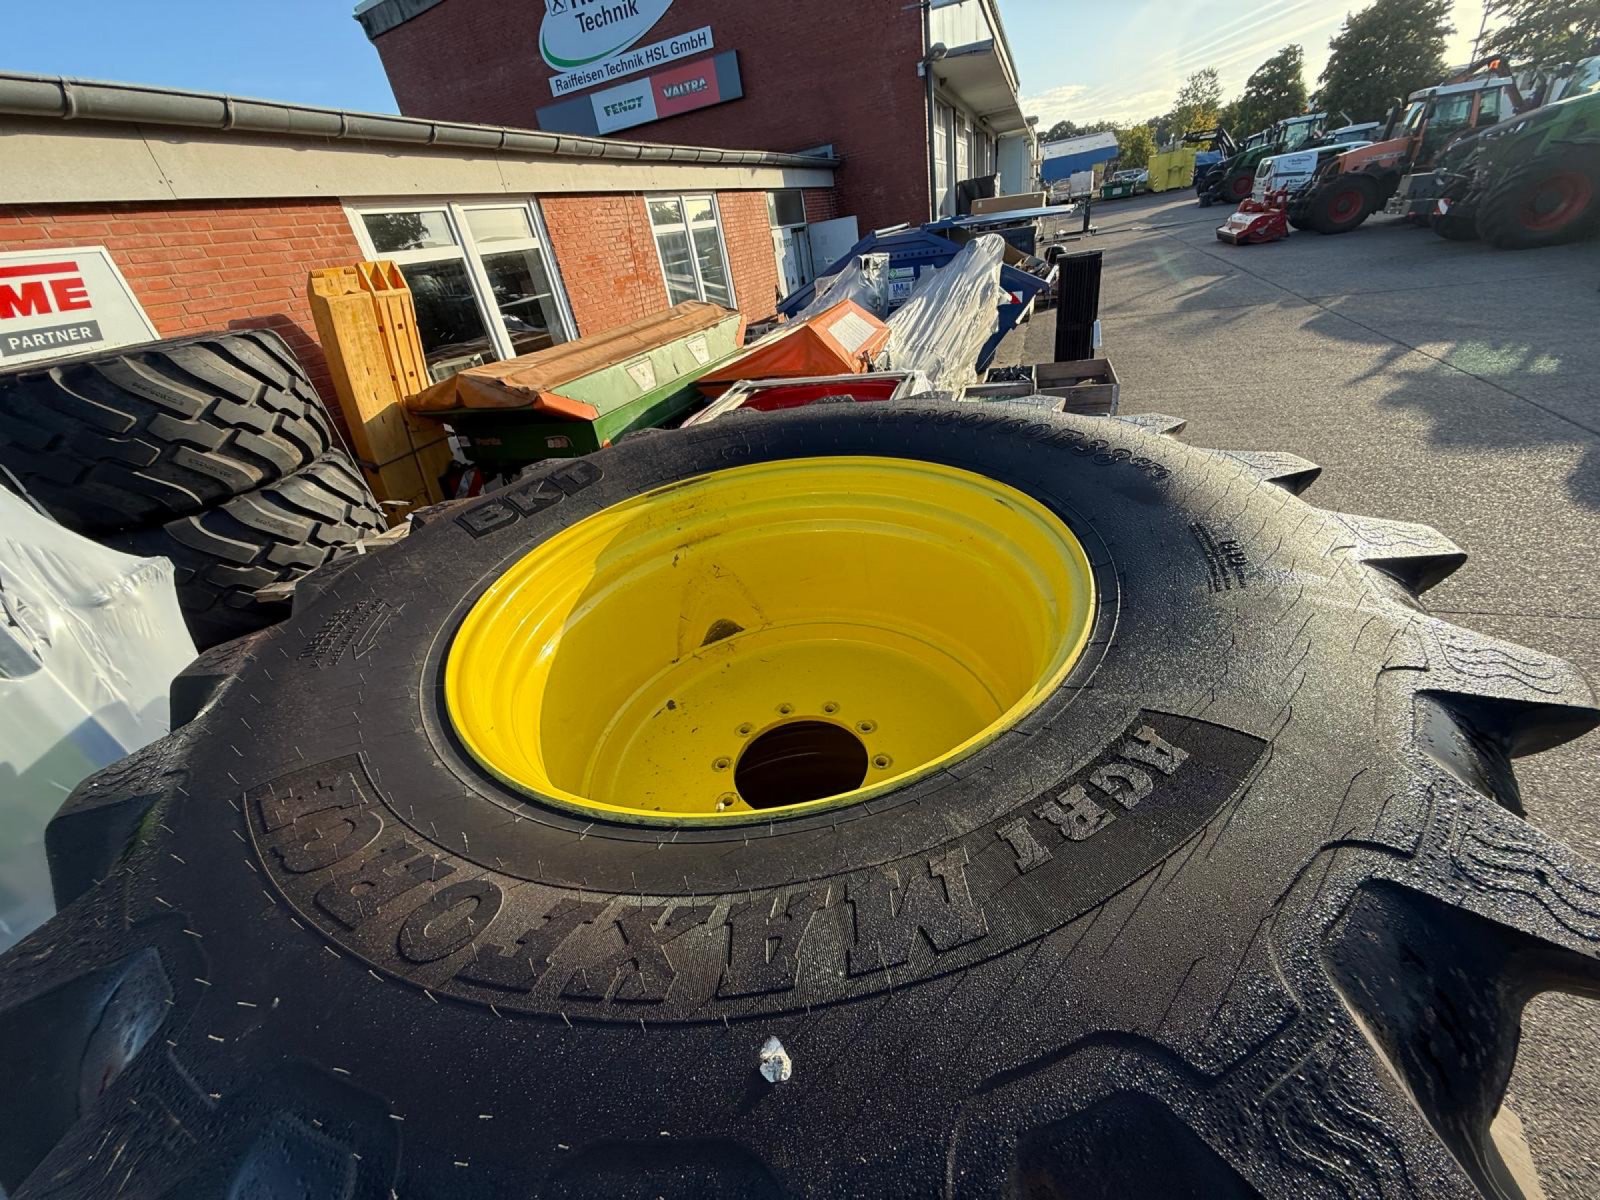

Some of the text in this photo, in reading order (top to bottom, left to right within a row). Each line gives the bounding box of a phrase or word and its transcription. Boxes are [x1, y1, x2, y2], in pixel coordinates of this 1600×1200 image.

[575, 0, 639, 33] Technik
[555, 32, 707, 92] Raiffeisen Technik HSL GmbH
[663, 77, 708, 98] VALTRA
[604, 96, 644, 117] FENDT
[8, 326, 93, 350] PARTNER
